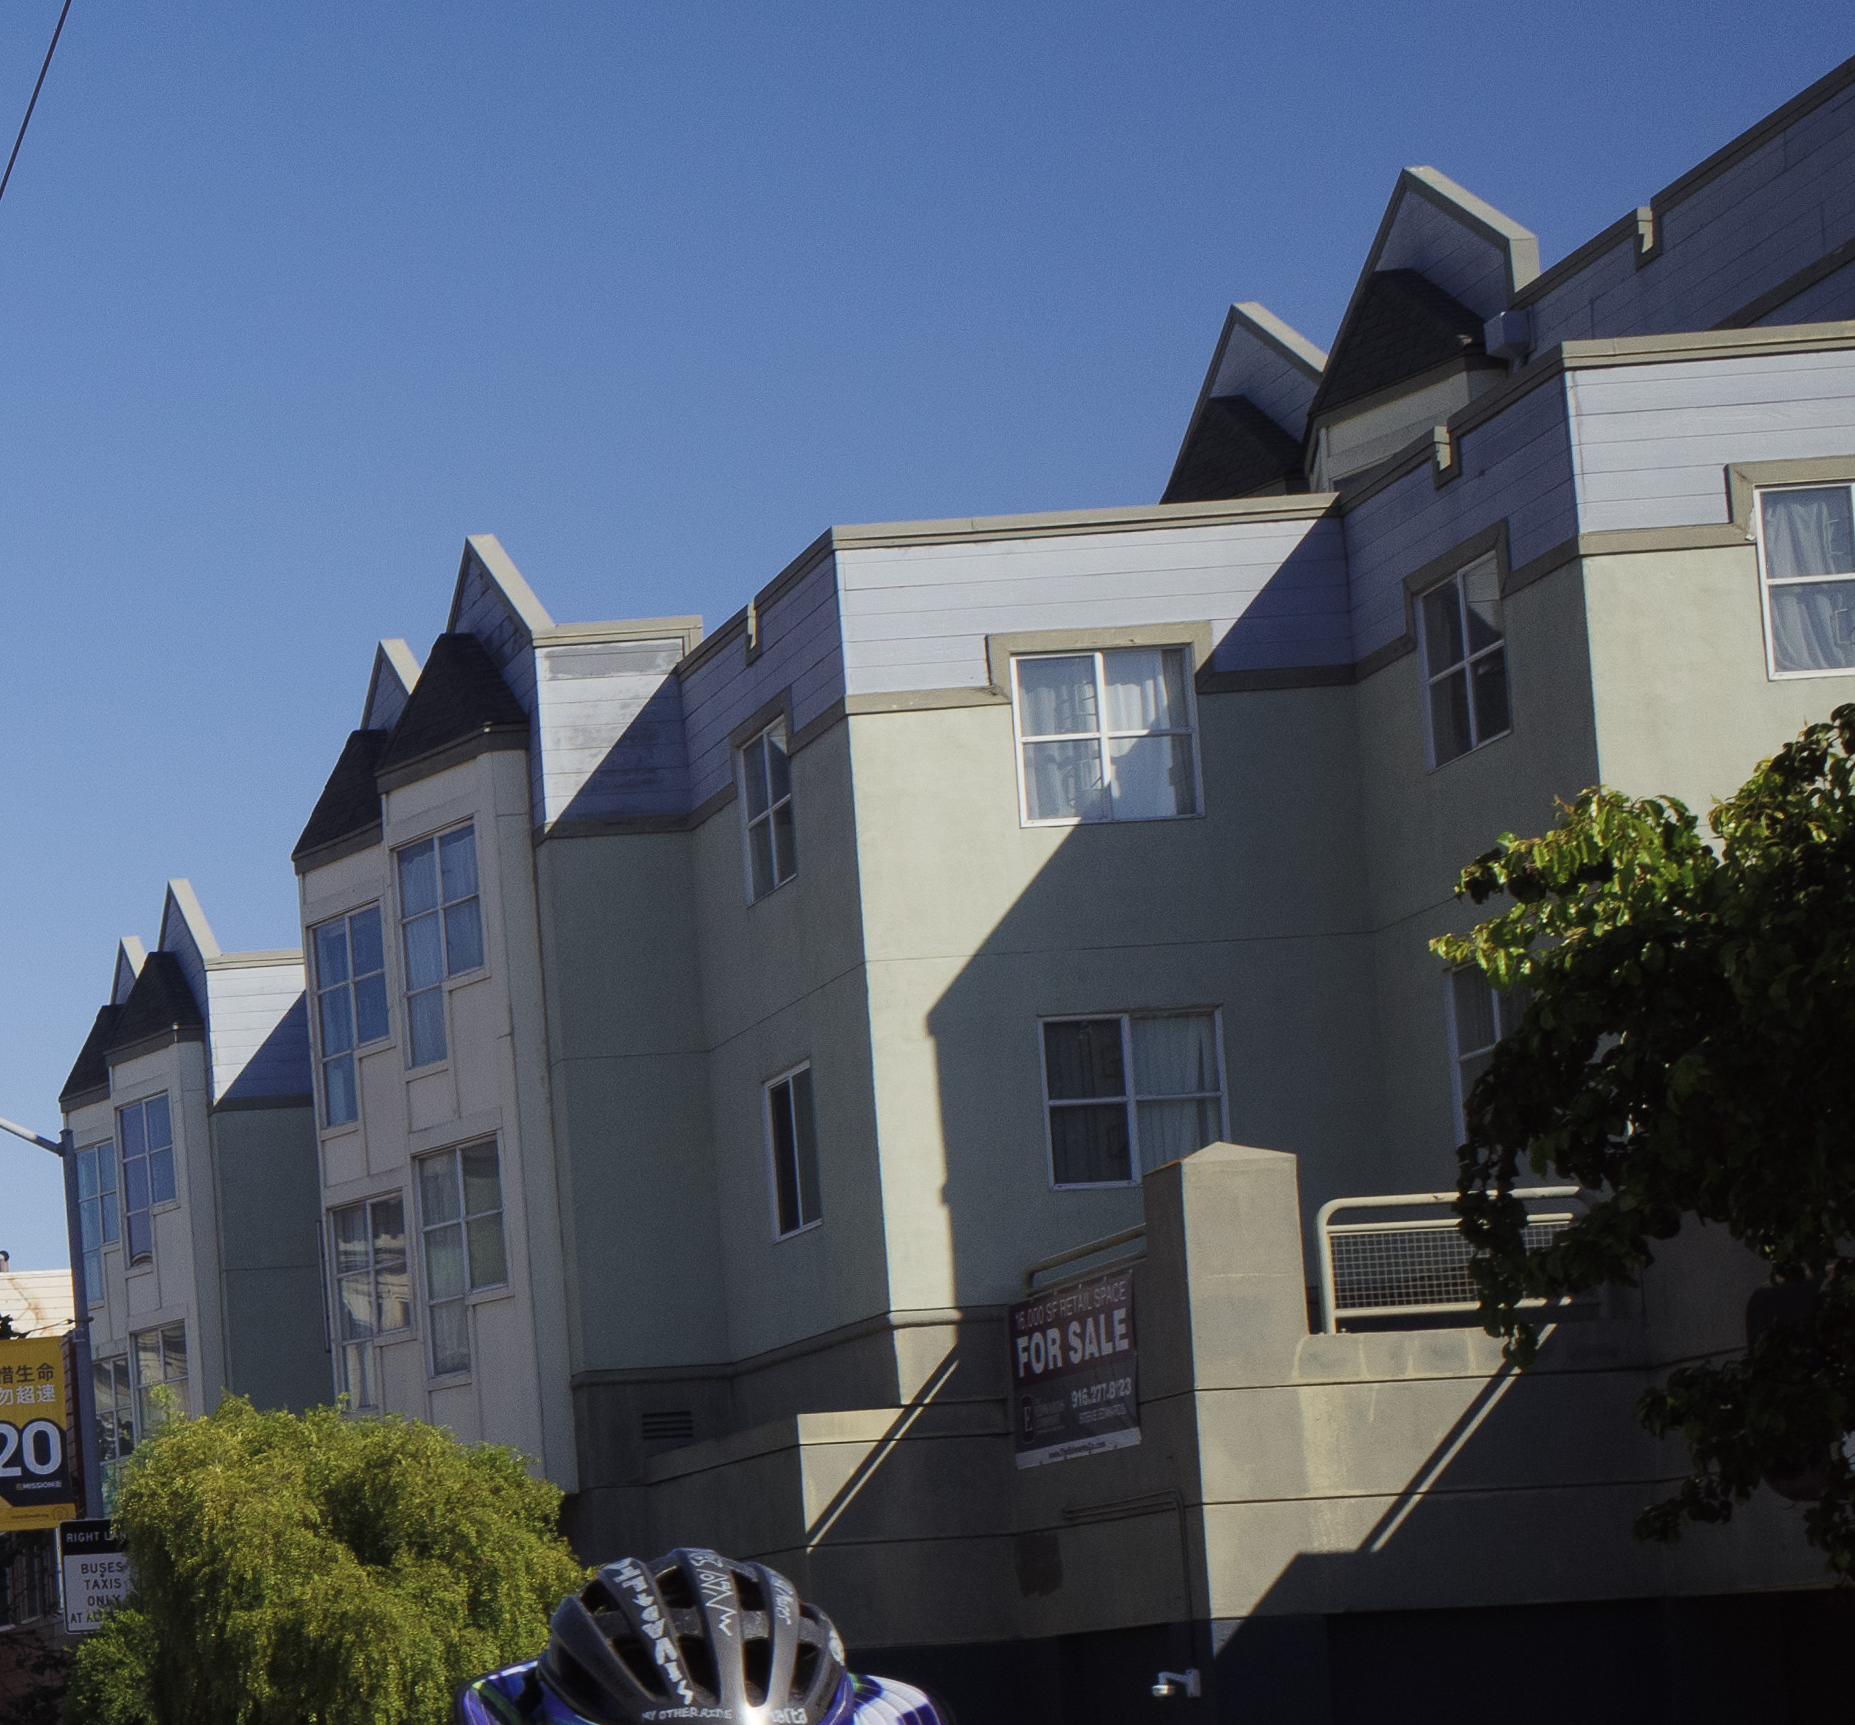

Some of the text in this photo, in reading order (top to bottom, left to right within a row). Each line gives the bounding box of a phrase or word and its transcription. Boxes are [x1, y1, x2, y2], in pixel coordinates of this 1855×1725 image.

[1016, 1308, 1130, 1378] FOR SALE
[65, 1532, 99, 1543] RIGHT
[80, 1561, 123, 1575] BUSES
[83, 1577, 122, 1590] TAXIS
[86, 1594, 122, 1606] ONLY
[70, 1612, 83, 1624] AT
